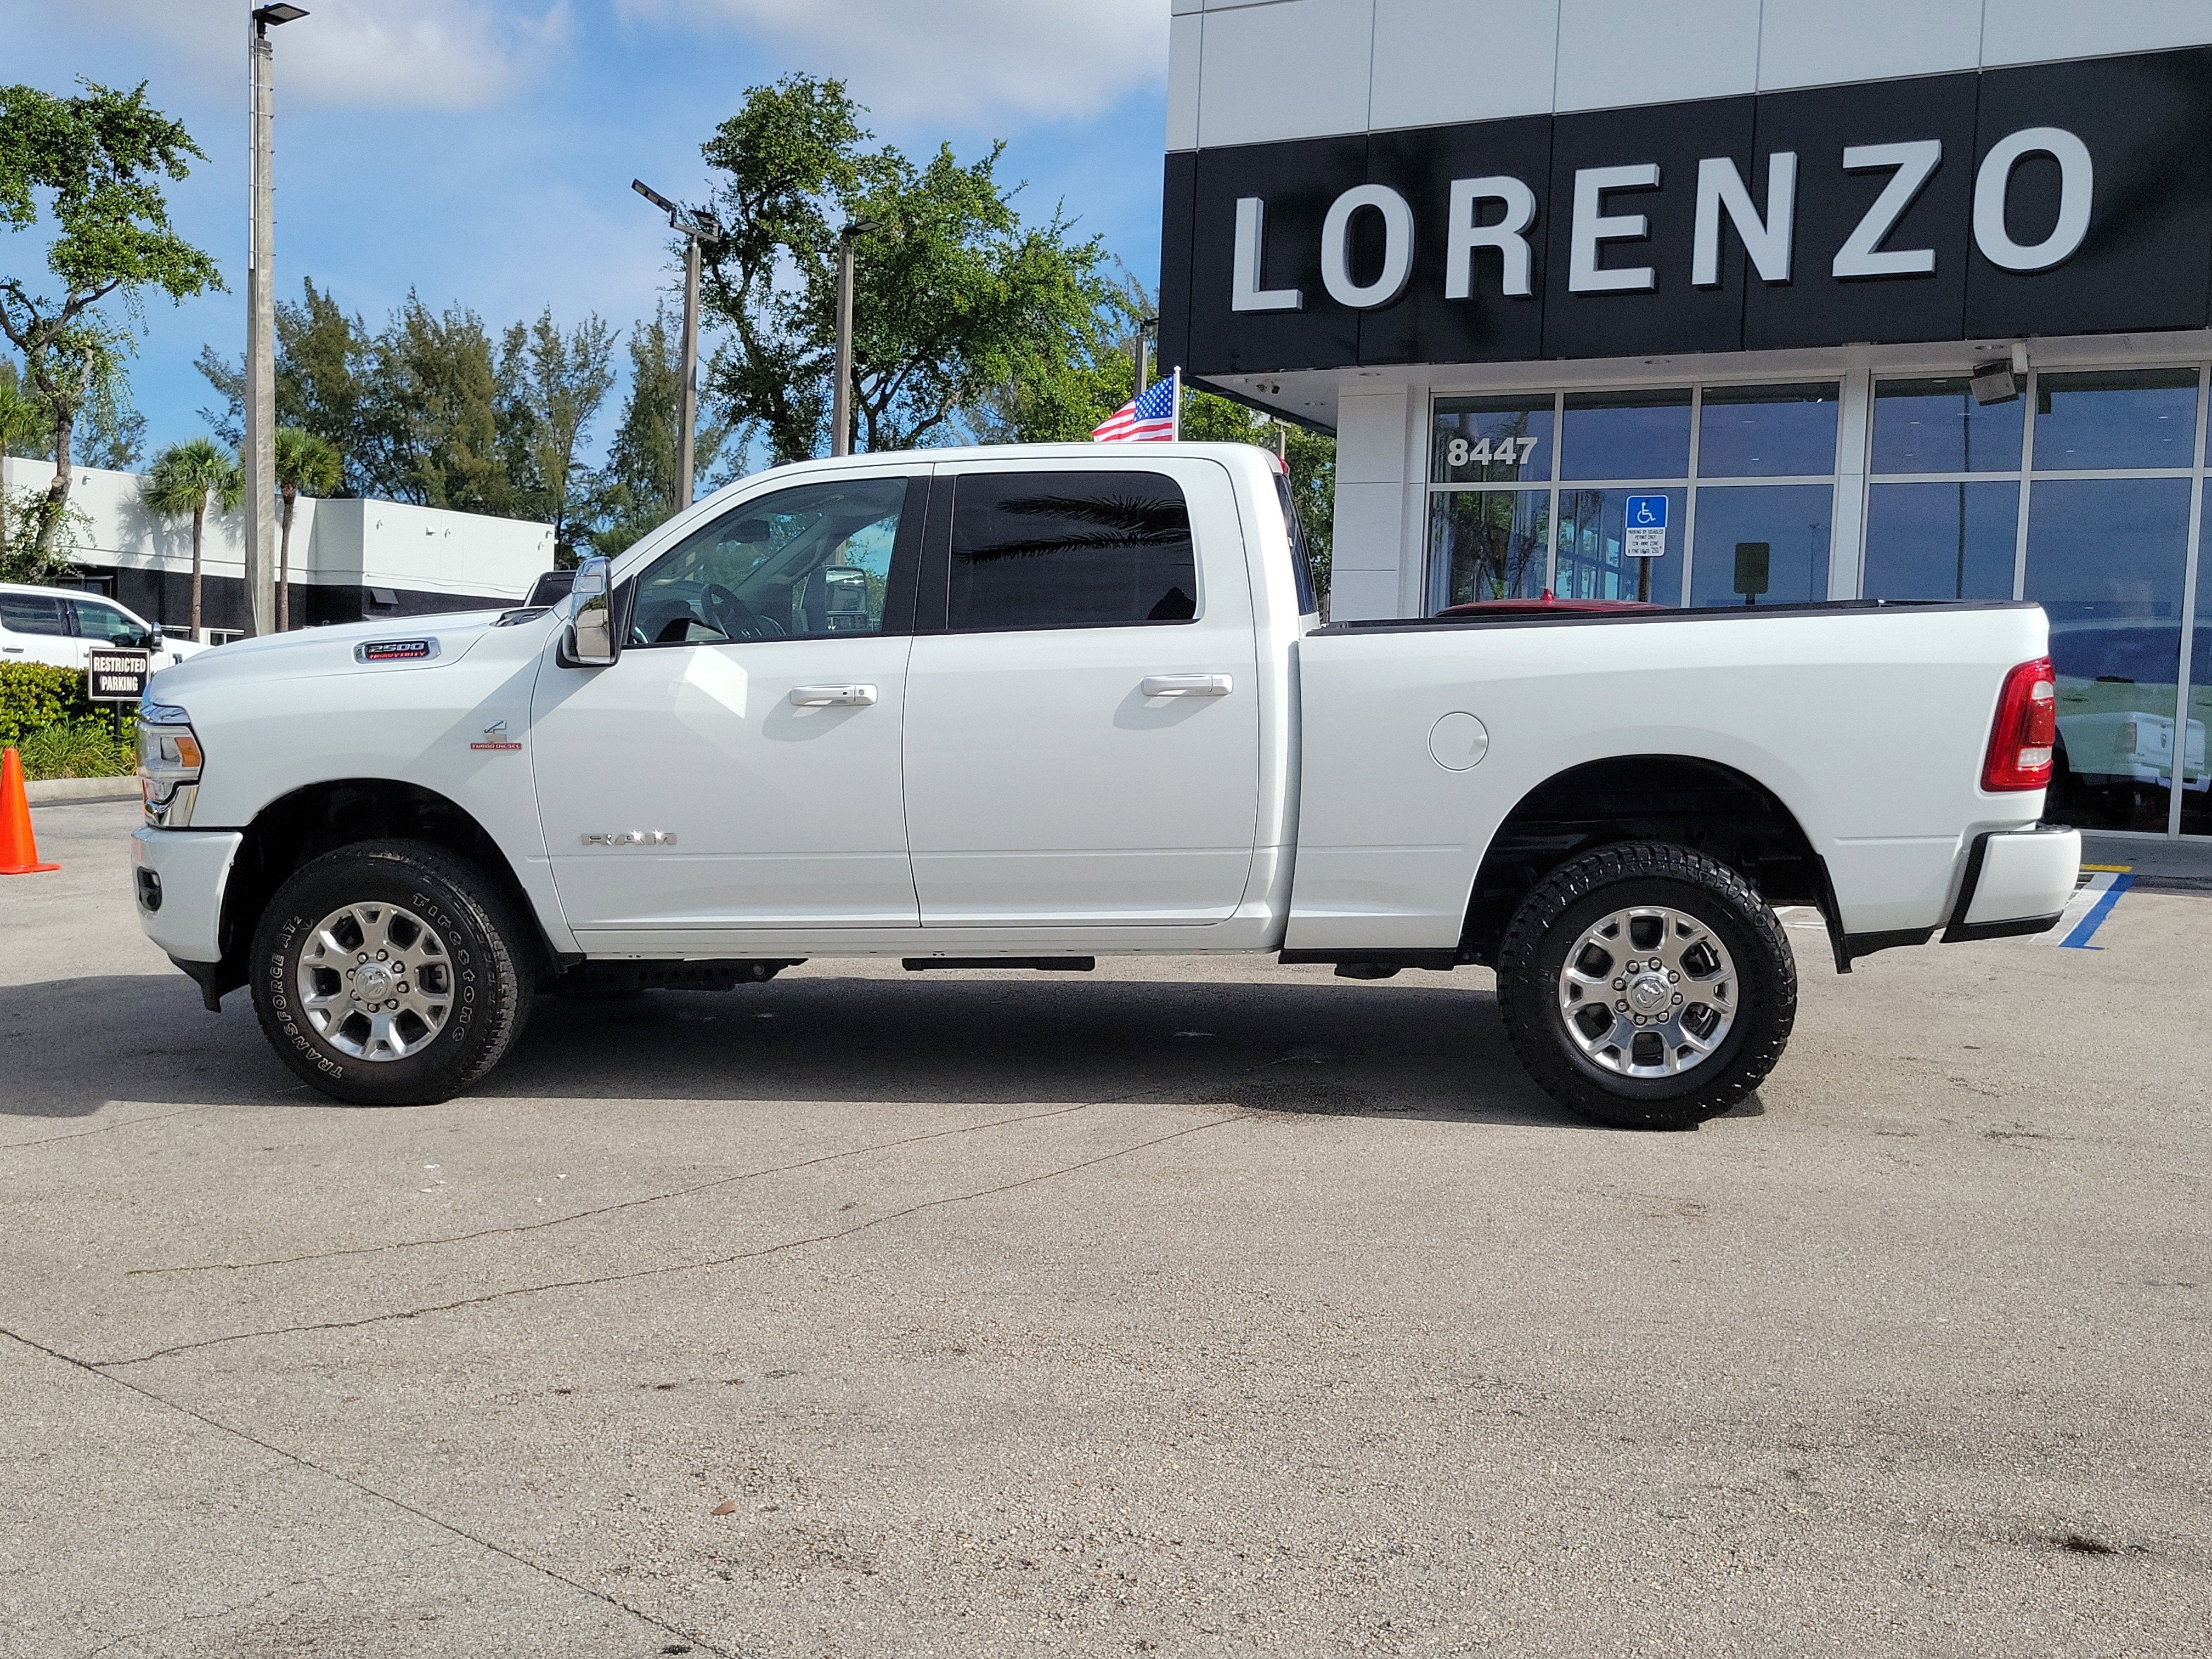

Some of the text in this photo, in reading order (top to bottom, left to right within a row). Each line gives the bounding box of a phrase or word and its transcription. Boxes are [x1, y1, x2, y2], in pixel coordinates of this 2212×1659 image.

[1232, 126, 2094, 312] LORENZO
[1447, 437, 1538, 466] 8447
[368, 642, 425, 653] 2500
[93, 656, 146, 673] RESTRICTED
[100, 675, 138, 691] PARKING
[580, 832, 678, 845] RAM
[270, 953, 343, 1079] TRANSFORCE
